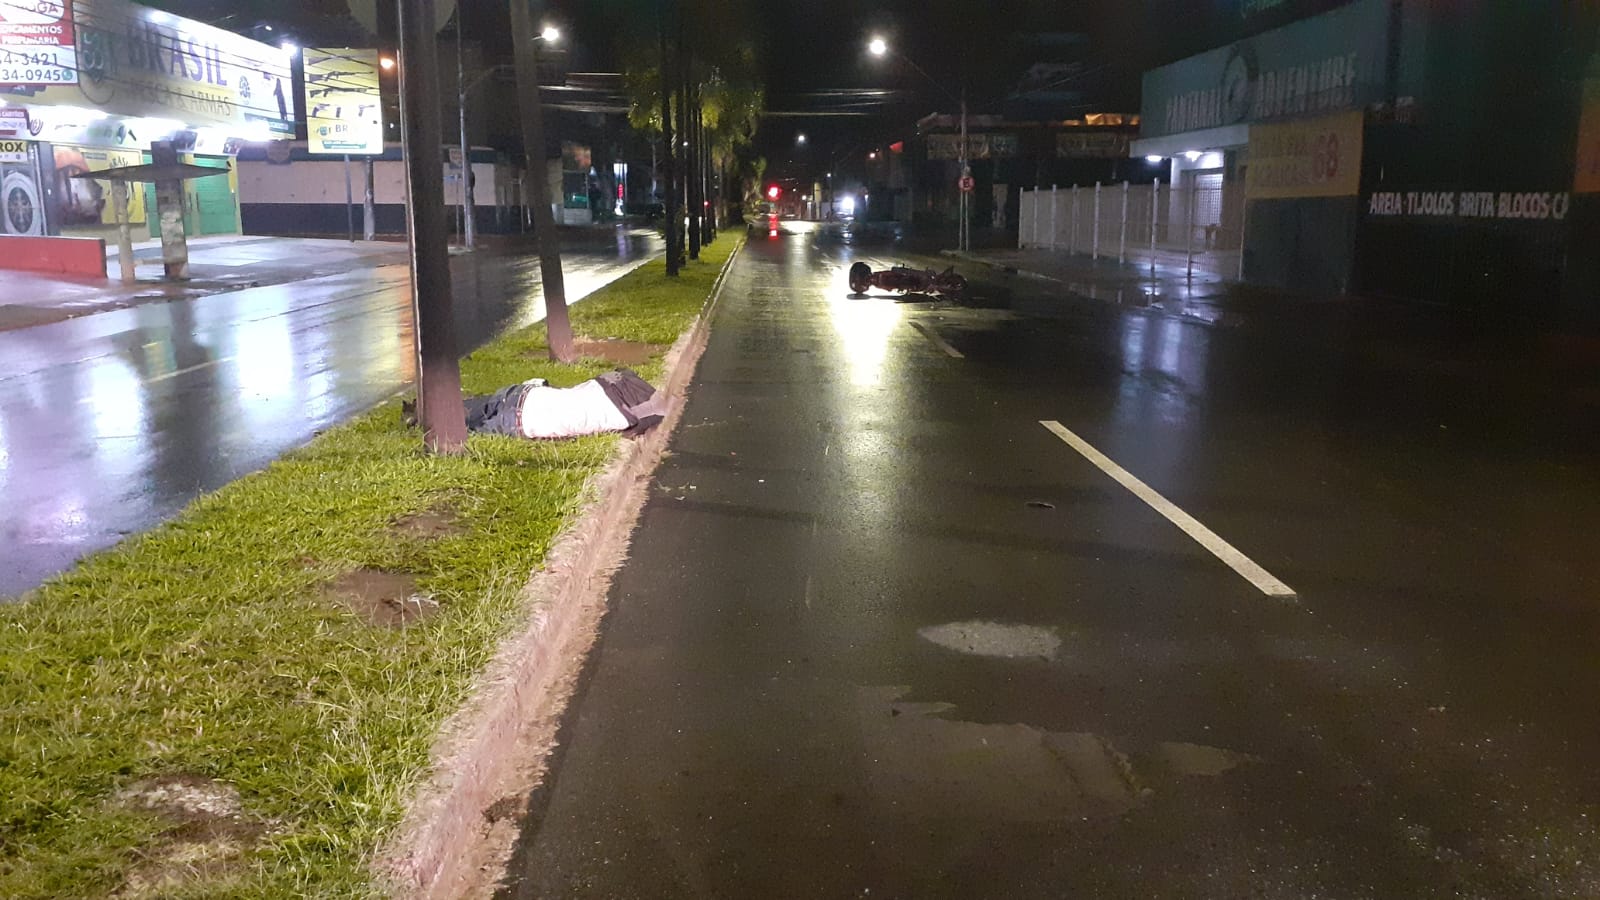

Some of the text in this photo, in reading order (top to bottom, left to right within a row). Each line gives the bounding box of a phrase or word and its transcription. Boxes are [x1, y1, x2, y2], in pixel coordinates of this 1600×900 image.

[126, 20, 228, 86] BRASIL
[191, 90, 231, 116] ARMAS
[1368, 192, 1403, 215] AREIA
[1406, 192, 1454, 216] TIJOLOS
[1459, 192, 1496, 217] BRITA
[1497, 192, 1549, 219] BLOCOS
